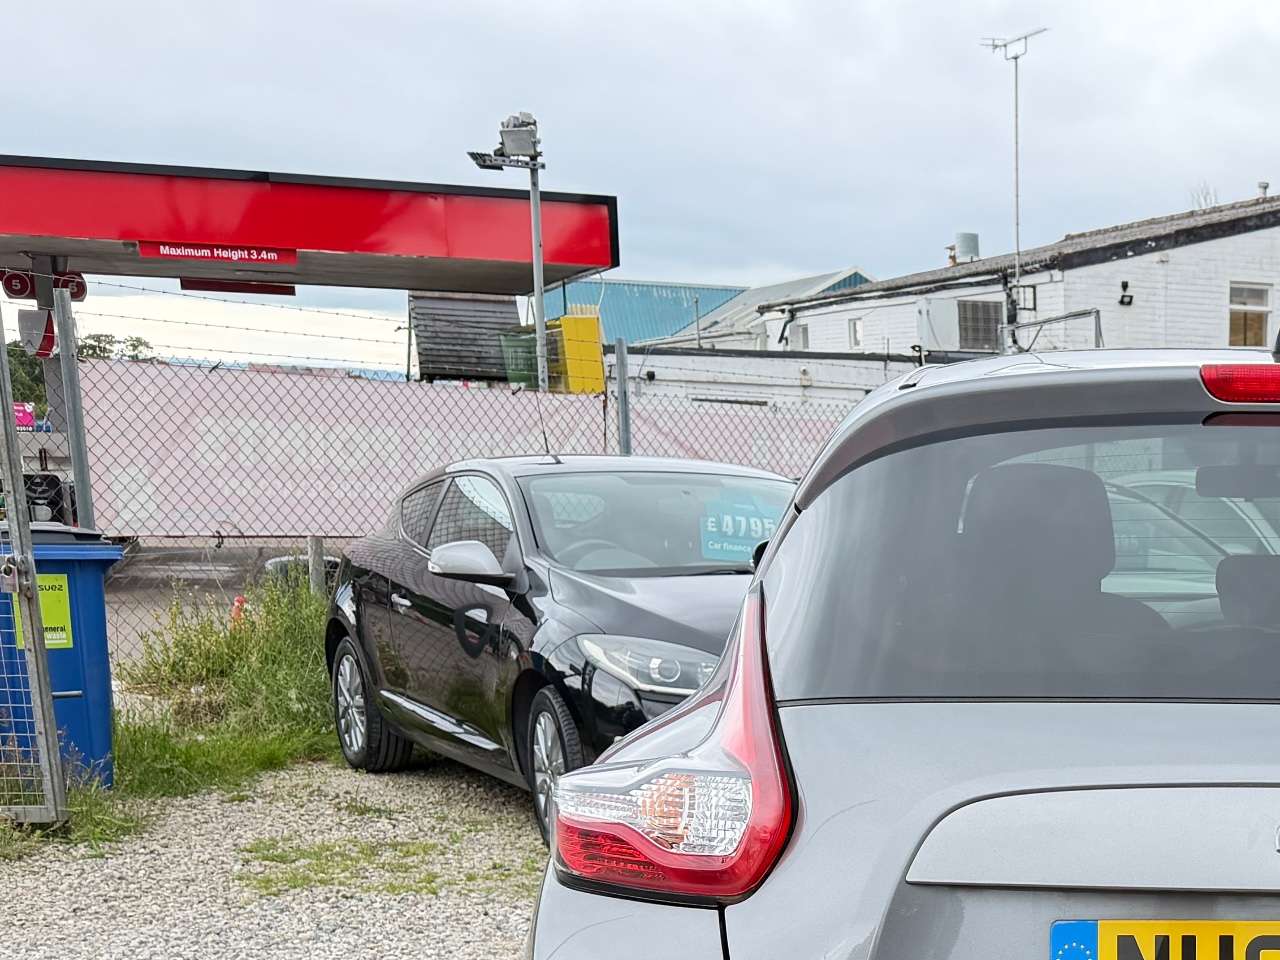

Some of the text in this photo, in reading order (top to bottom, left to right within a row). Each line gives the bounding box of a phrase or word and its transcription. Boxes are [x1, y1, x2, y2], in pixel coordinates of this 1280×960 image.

[159, 245, 278, 261] Maximum Height 3.4m
[12, 279, 21, 290] 5
